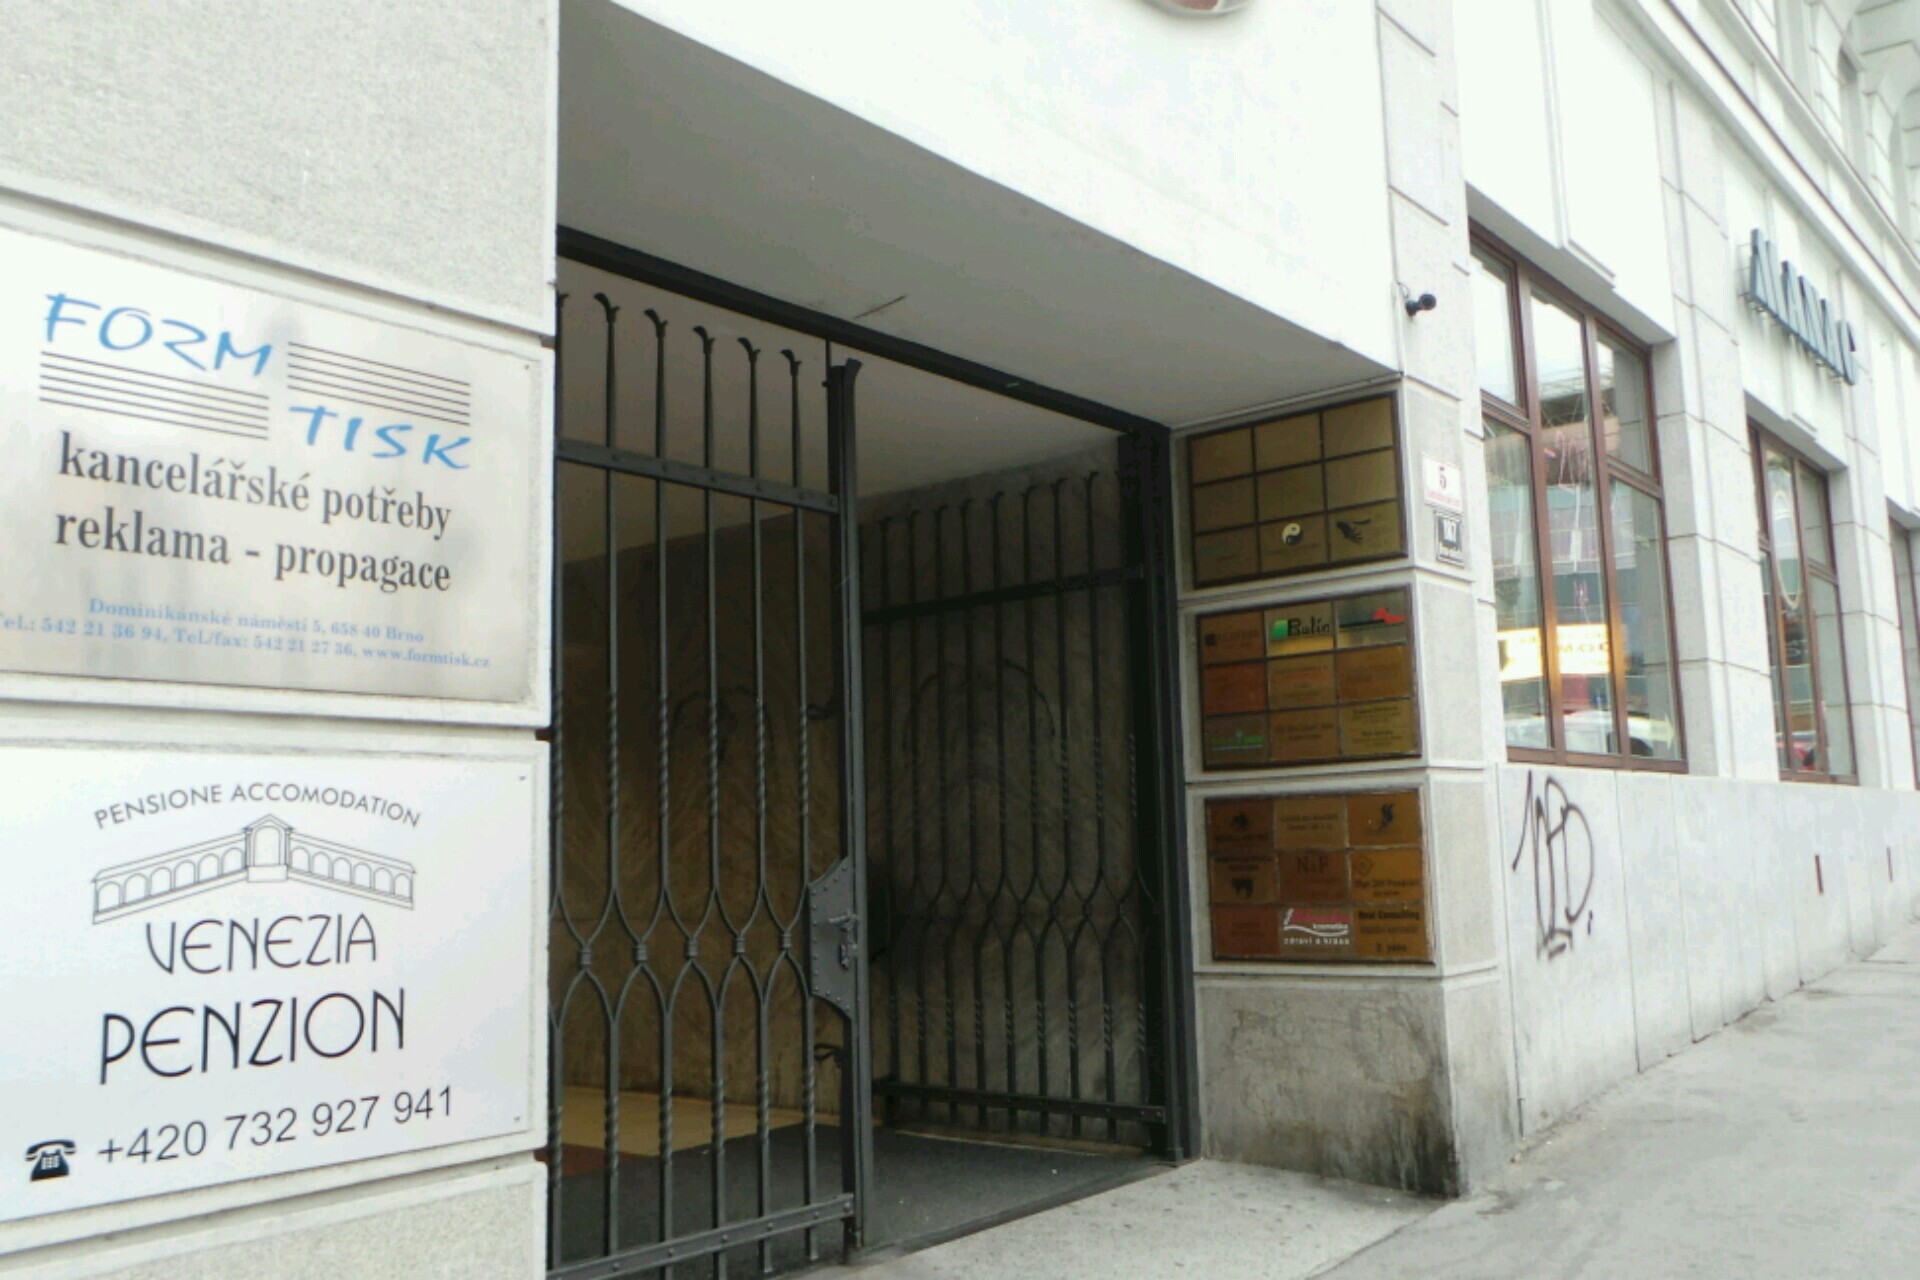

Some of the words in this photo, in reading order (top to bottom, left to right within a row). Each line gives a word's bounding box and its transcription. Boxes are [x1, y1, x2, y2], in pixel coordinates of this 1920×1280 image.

[44, 292, 272, 377] FORM
[289, 405, 472, 470] TISK
[59, 430, 310, 512] kancelářské
[322, 486, 452, 541] potřeby
[1439, 465, 1447, 489] 5
[54, 506, 230, 565] reklama
[274, 540, 452, 593] propagace
[41, 616, 77, 635] 542
[84, 619, 104, 638] 21
[253, 635, 282, 652] 542
[88, 597, 232, 626] Dominikánské
[386, 625, 425, 643] Brno
[94, 783, 222, 829] PENSIONE
[231, 782, 422, 827] ACCOMODATION
[146, 913, 377, 975] VENEZIA
[99, 988, 404, 1085] PENZION
[98, 1120, 207, 1164] +420
[225, 1107, 297, 1150] 732
[312, 1096, 380, 1136] 927
[394, 1086, 453, 1124] 941
